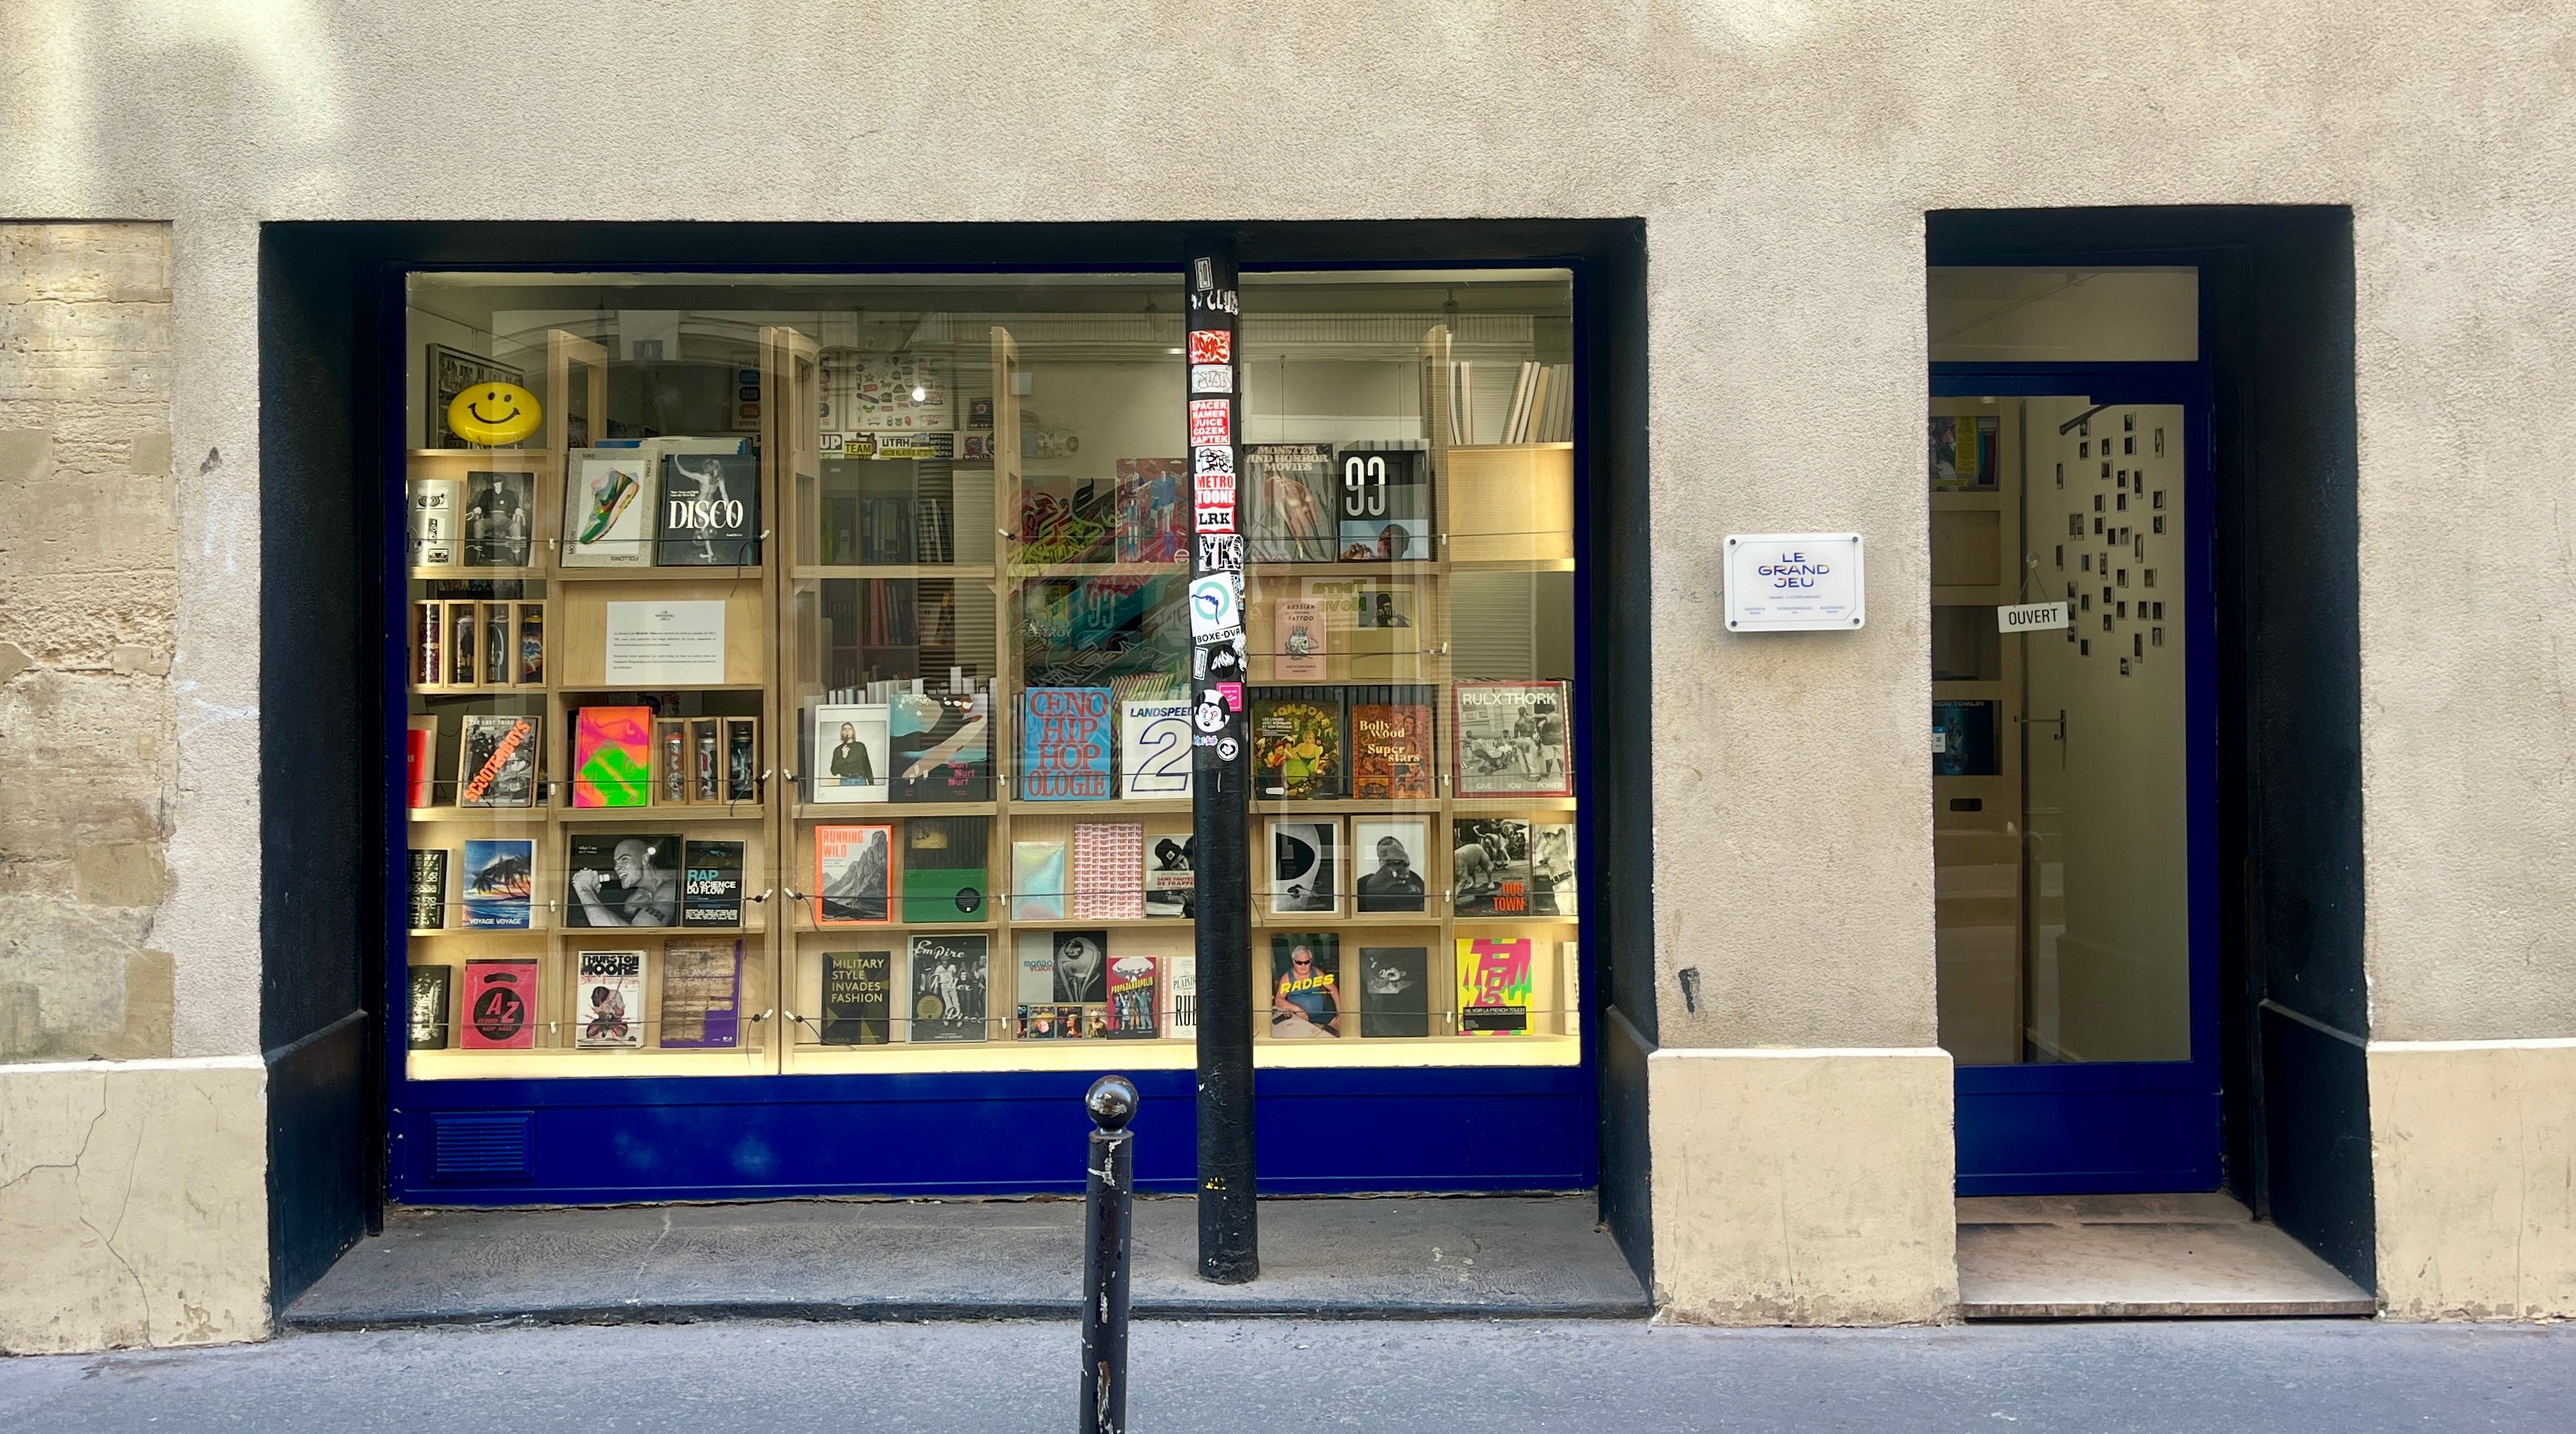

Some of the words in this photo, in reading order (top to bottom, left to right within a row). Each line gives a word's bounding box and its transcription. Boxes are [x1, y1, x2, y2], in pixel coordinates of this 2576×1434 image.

[845, 444, 871, 453] TEAM
[1257, 446, 1317, 454] MONSTER
[1275, 454, 1328, 463] HORROR
[1264, 462, 1312, 471] MOVIES
[1197, 475, 1233, 488] METRO
[1345, 456, 1386, 517] 93
[1197, 490, 1234, 504] TOONE
[668, 499, 744, 530] DISCO
[1199, 513, 1230, 525] LRK
[1783, 552, 1806, 563] LE
[1758, 564, 1830, 576] GRAND
[1774, 578, 1814, 588] JEU
[2009, 608, 2059, 626] OUVERT
[1463, 693, 1502, 705] RULX
[1504, 693, 1556, 705] THORK
[1042, 718, 1098, 744] HIP
[1360, 720, 1392, 731] Bolly
[1131, 718, 1193, 792] 2
[1368, 744, 1405, 757] Super
[463, 719, 531, 803] SCOOTERBOYS
[1038, 744, 1100, 770] HOP
[1387, 753, 1420, 762] stars
[1028, 770, 1106, 798] OLOGIE
[823, 830, 864, 844] RUNNING
[823, 845, 848, 858] WILD
[688, 869, 719, 881] RAP
[1502, 882, 1525, 894] DOG
[1494, 897, 1525, 911] TOWN
[582, 955, 639, 965] THURSTON
[832, 959, 885, 969] MILITARY
[581, 964, 639, 975] MOORE
[832, 971, 865, 980] STYLE
[832, 982, 882, 992] INVADES
[1280, 974, 1335, 994] RADES
[831, 993, 883, 1003] FASHION
